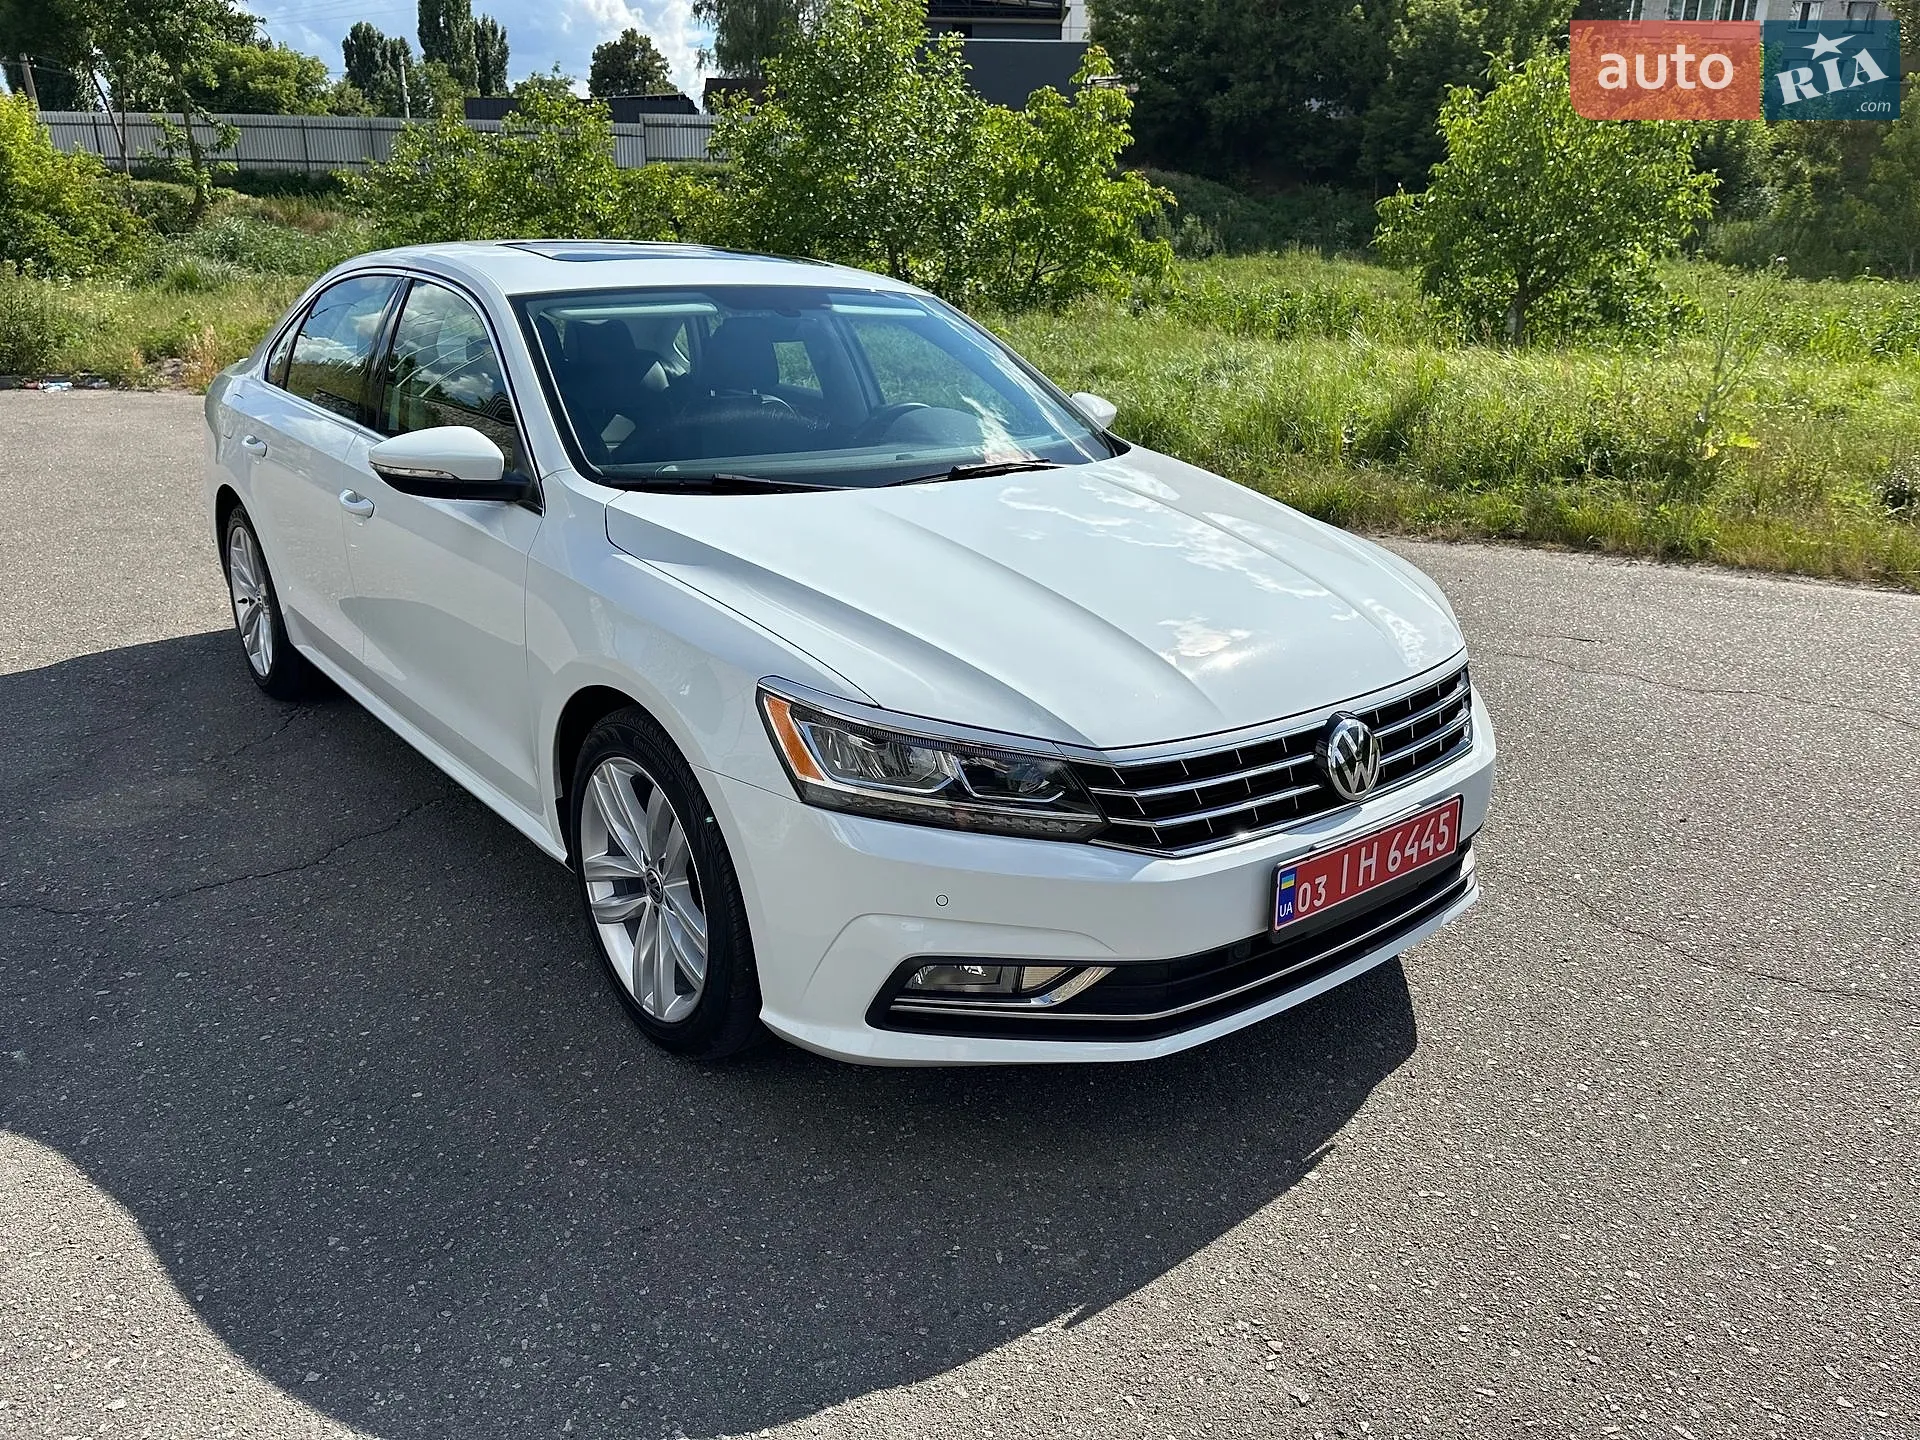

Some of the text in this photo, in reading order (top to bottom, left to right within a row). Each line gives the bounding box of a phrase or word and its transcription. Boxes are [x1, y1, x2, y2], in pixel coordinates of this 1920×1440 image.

[1297, 811, 1451, 913] 03 IH 6445
[1280, 902, 1293, 917] UA
